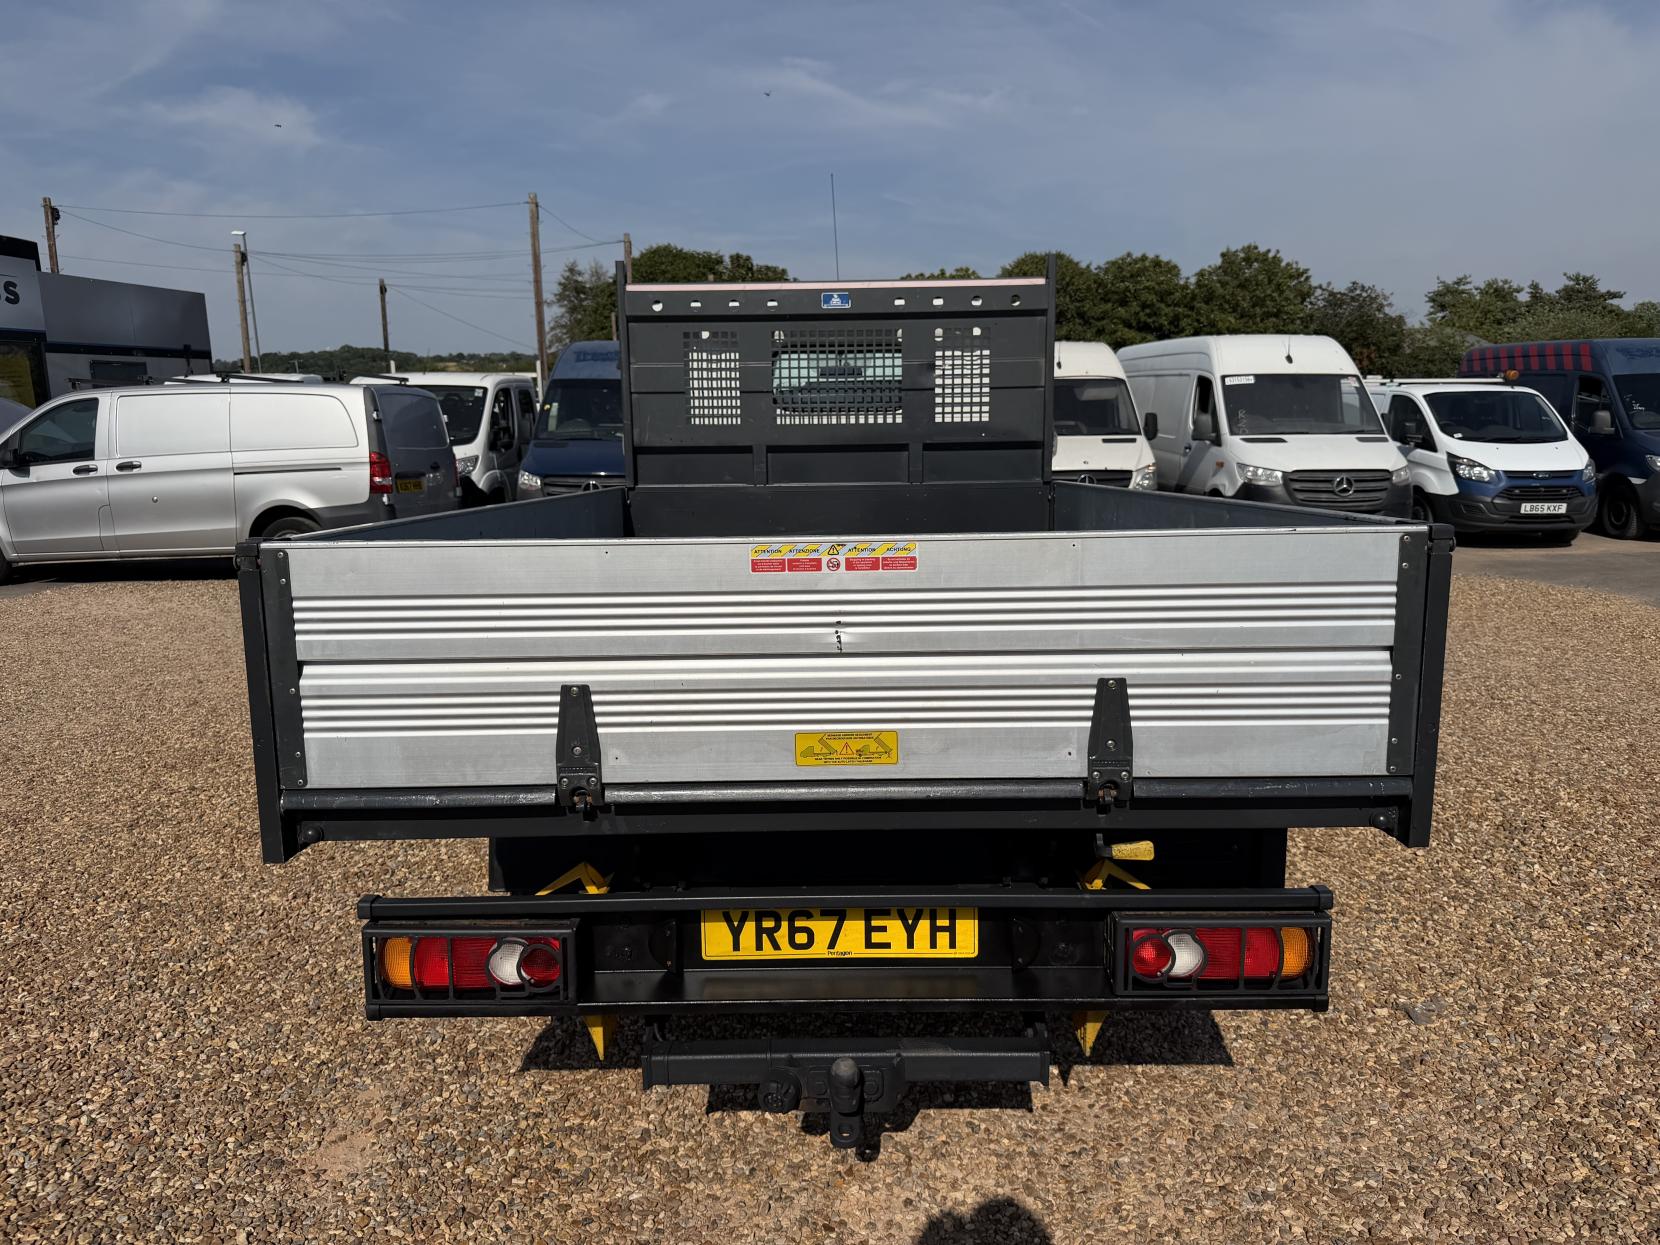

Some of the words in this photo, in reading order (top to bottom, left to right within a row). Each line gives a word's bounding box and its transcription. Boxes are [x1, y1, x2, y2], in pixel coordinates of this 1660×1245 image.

[1523, 504, 1545, 512] LB65
[1546, 504, 1563, 512] KXF
[722, 909, 847, 952] YR67
[864, 908, 957, 950] EYH
